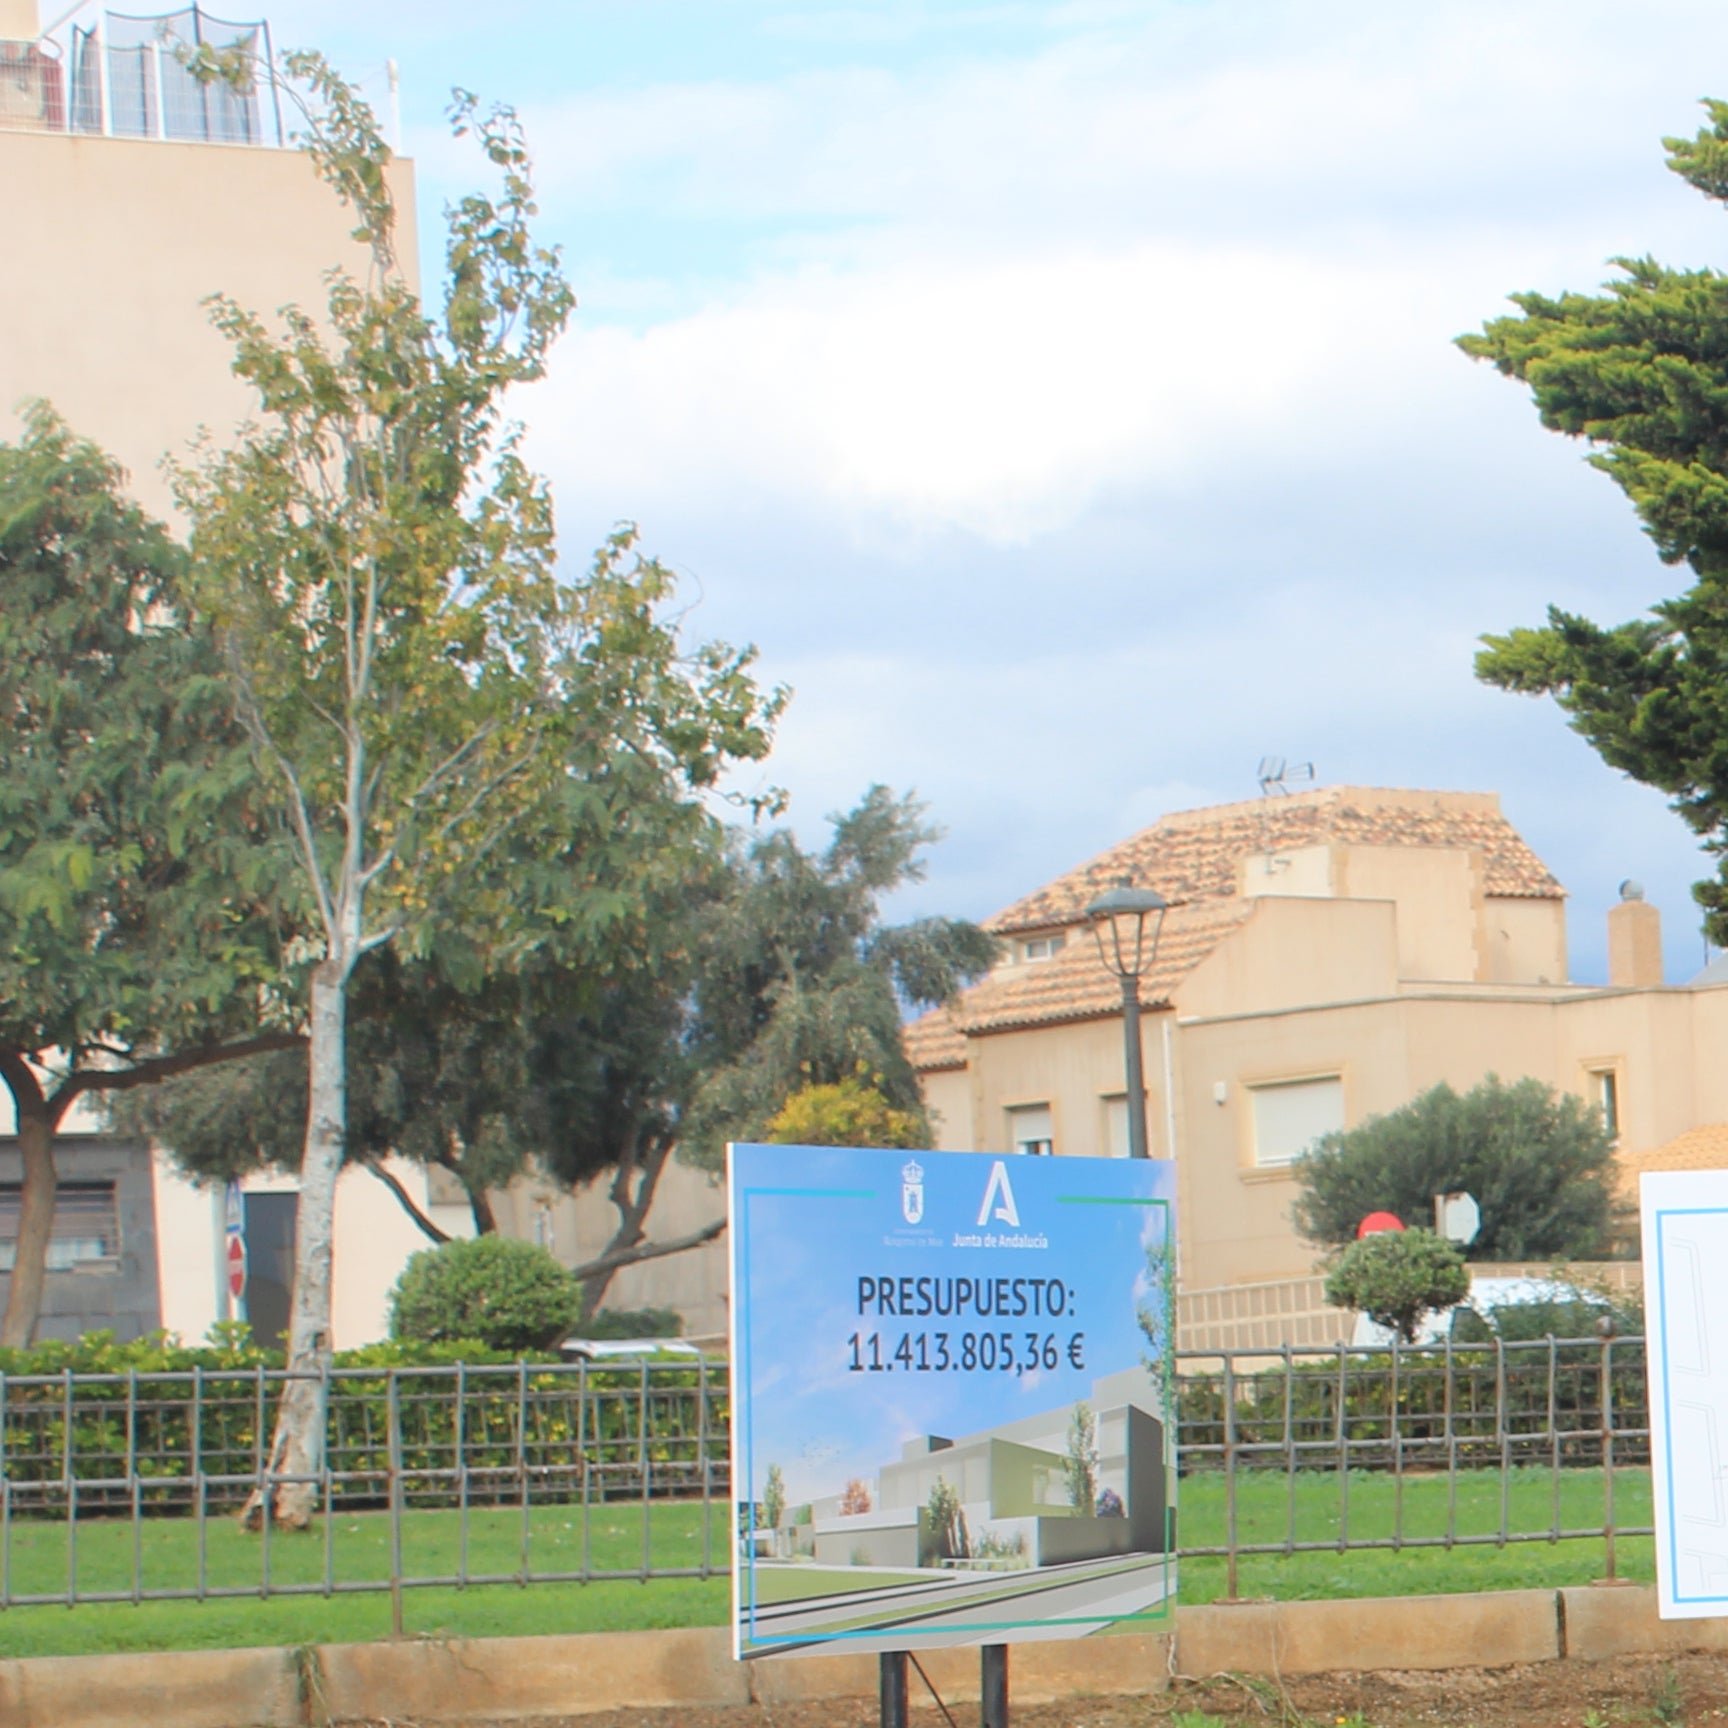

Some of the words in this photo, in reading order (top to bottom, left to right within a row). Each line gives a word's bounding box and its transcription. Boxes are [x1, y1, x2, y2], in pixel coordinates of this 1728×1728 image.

[857, 1276, 1076, 1317] PRESUPUESTO:
[847, 1332, 1059, 1377] 11.413.805,36
[1066, 1332, 1086, 1371] €
